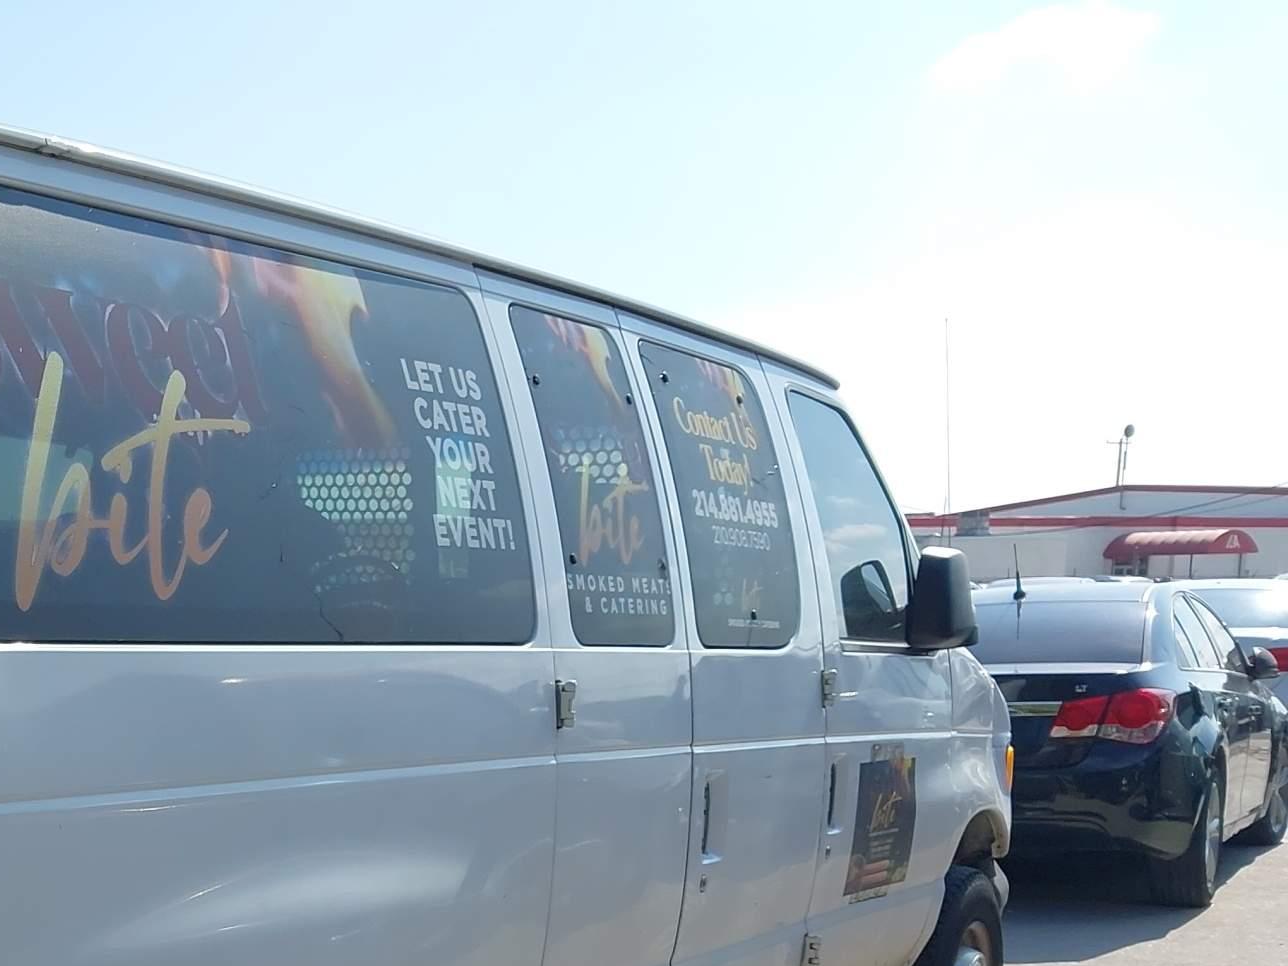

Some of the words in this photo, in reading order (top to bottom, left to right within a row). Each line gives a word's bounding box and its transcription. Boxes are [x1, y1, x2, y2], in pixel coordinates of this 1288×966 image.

[400, 358, 445, 394] LET
[448, 366, 481, 400] US
[414, 396, 490, 438] CATER
[672, 396, 736, 445] Contact
[730, 412, 757, 450] Us
[425, 435, 494, 475] YOUR
[699, 443, 754, 496] Today!
[16, 351, 250, 612] bite
[437, 475, 496, 511] NEXT
[579, 457, 649, 567] bite
[692, 489, 779, 529] 214.881.4955
[432, 513, 515, 550] EVENT!
[567, 573, 624, 593] SMOKED
[585, 596, 593, 613] &
[600, 597, 667, 616] CATERING
